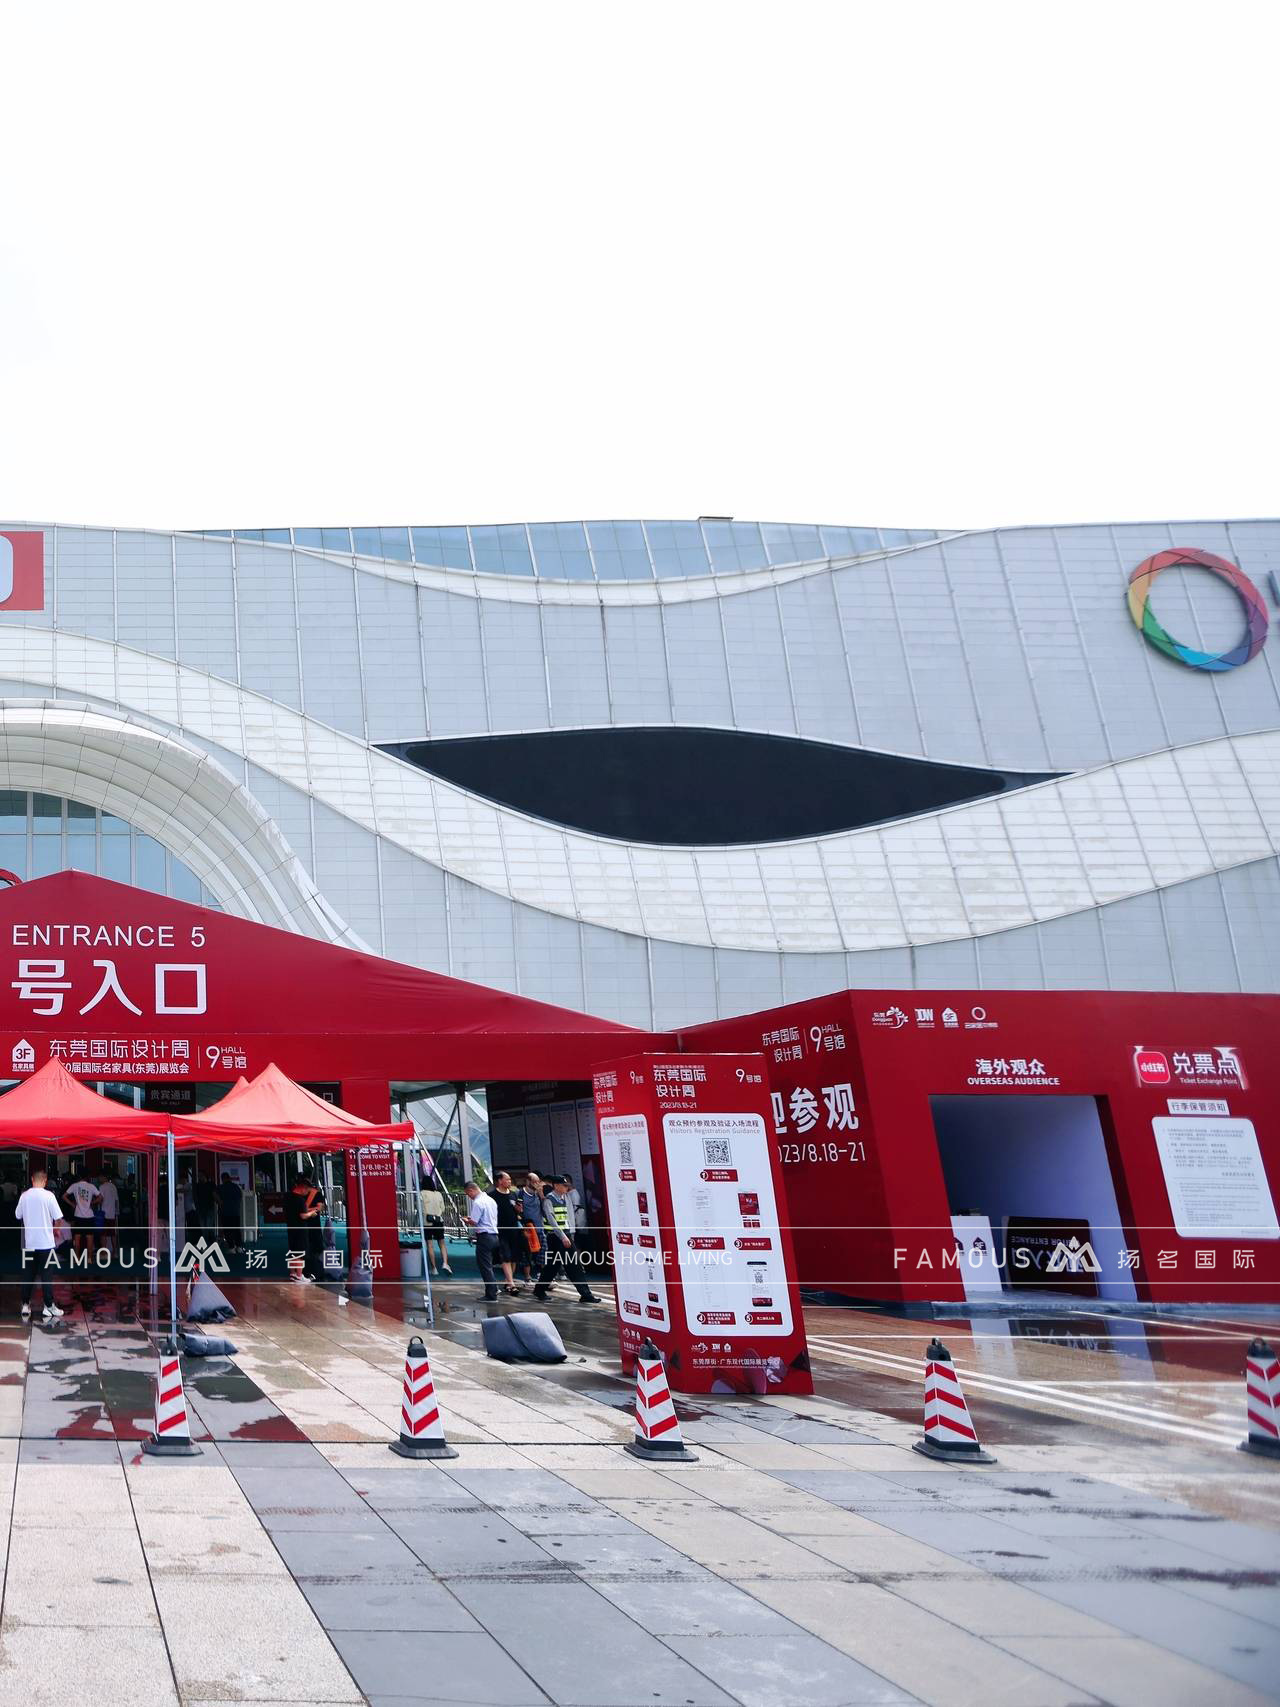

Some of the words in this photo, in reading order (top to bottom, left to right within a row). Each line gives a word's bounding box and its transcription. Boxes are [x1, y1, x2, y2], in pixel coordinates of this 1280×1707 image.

[12, 925, 175, 947] ENTRANCE
[191, 926, 206, 947] 5
[11, 960, 207, 1016] 号入口
[762, 1027, 800, 1046] 东莞国际
[810, 1027, 822, 1052] 9
[822, 1024, 842, 1034] HALL
[824, 1035, 846, 1051] 号馆
[15, 1048, 32, 1060] 3F
[49, 1039, 190, 1059] 东莞国际设计周
[206, 1045, 220, 1069] 9
[774, 1045, 802, 1063] 设计周
[222, 1056, 246, 1069] 号馆
[976, 1058, 1046, 1075] 海外观众
[1173, 1052, 1239, 1075] 兑票点
[653, 1069, 707, 1082] 东莞国际
[967, 1077, 1013, 1085] OVERSEAS
[1014, 1077, 1060, 1085] AUDIENCE
[656, 1085, 696, 1098] 设计周
[1172, 1103, 1226, 1112] 行李保管须知
[669, 1120, 759, 1128] 观众预约参观及验证入场流程
